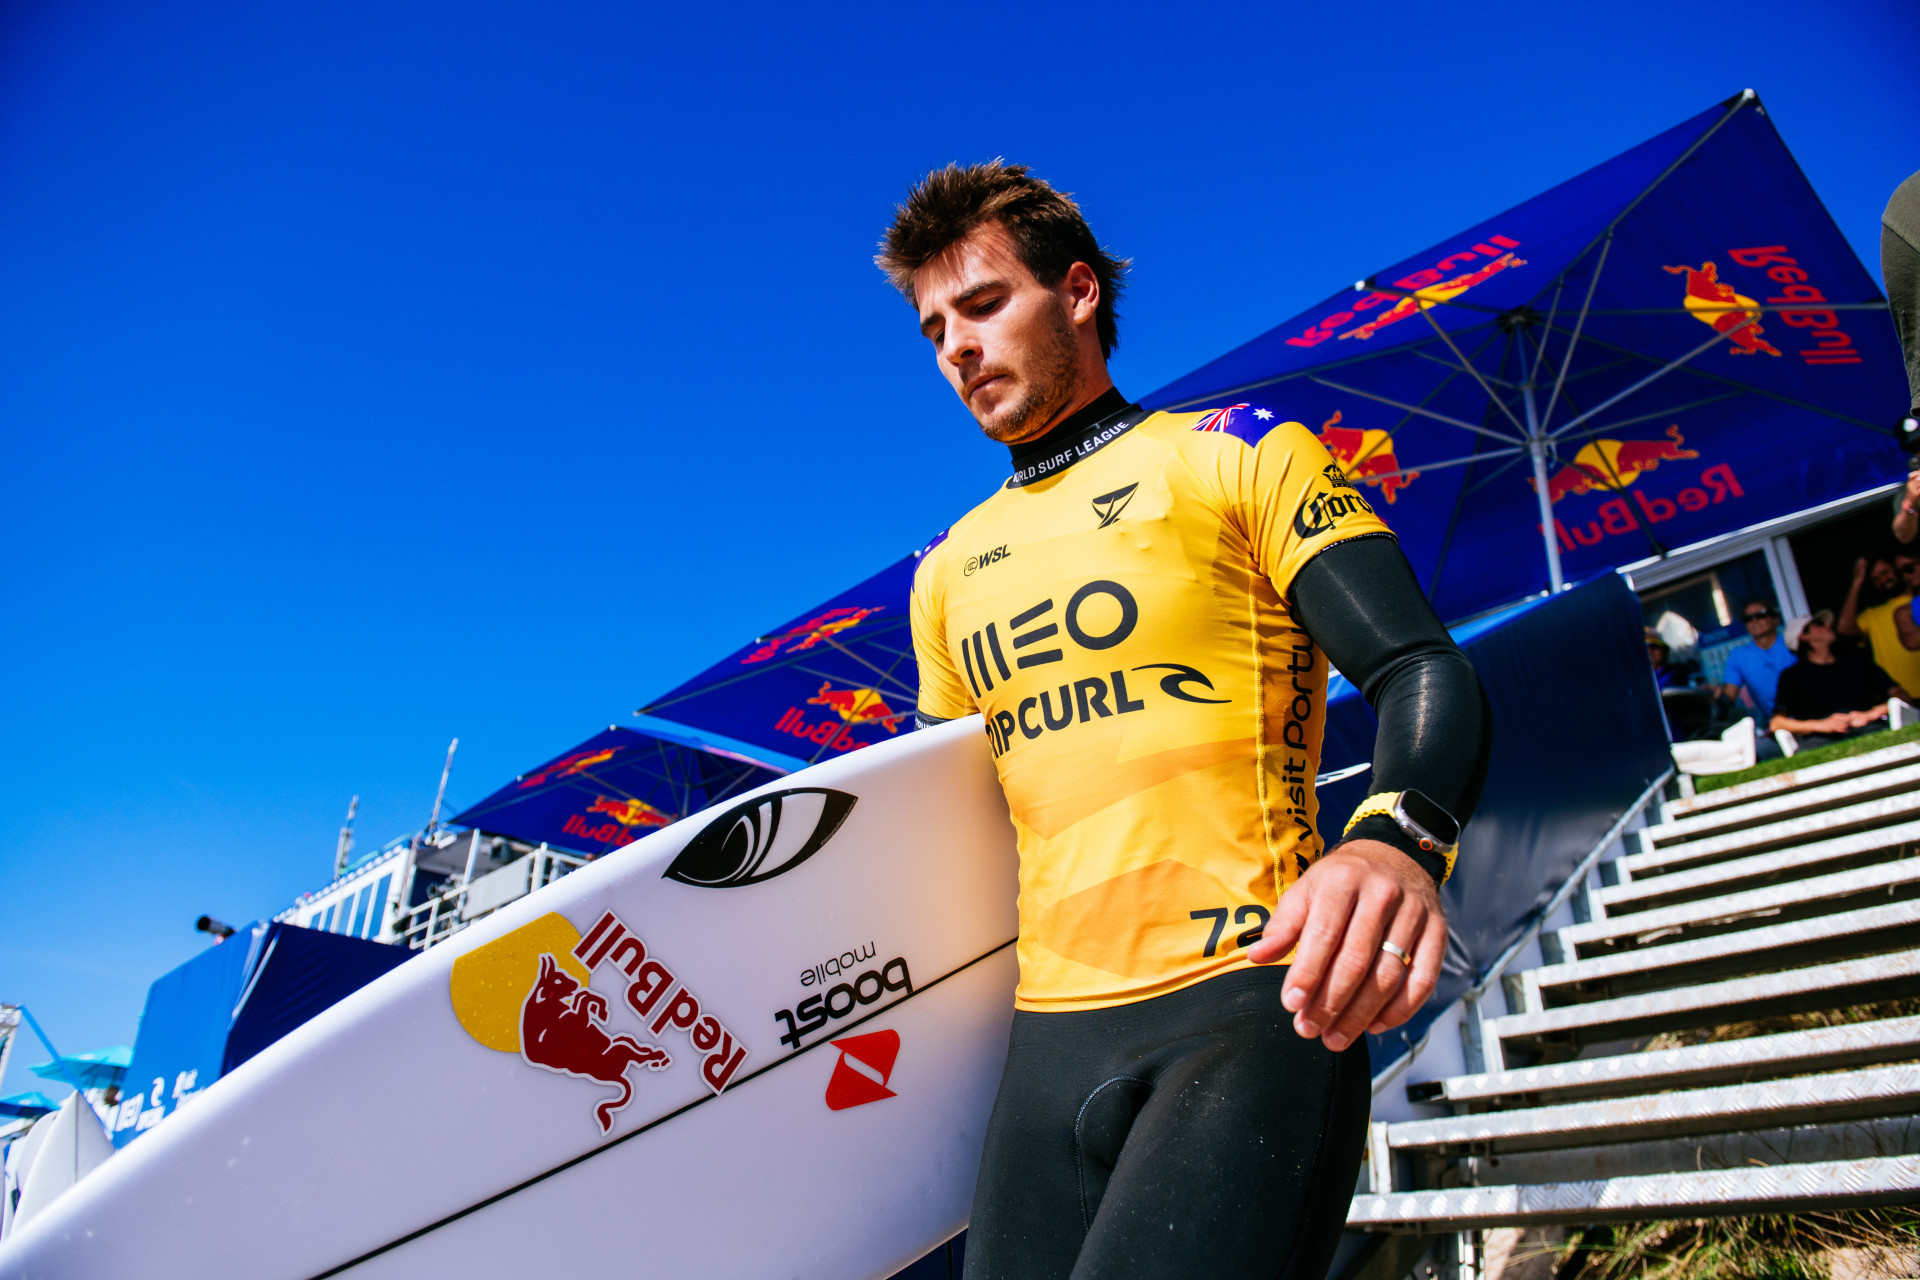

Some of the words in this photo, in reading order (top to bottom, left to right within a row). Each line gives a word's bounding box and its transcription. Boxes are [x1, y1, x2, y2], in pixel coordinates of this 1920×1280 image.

[1038, 449, 1074, 474] SURF
[1075, 421, 1130, 457] LEAGUE
[979, 544, 1012, 570] WSL
[962, 580, 1139, 698] MEO
[1282, 757, 1313, 842] visit
[1189, 904, 1271, 958] 72
[800, 941, 876, 987] mobile
[774, 956, 914, 1050] boost
